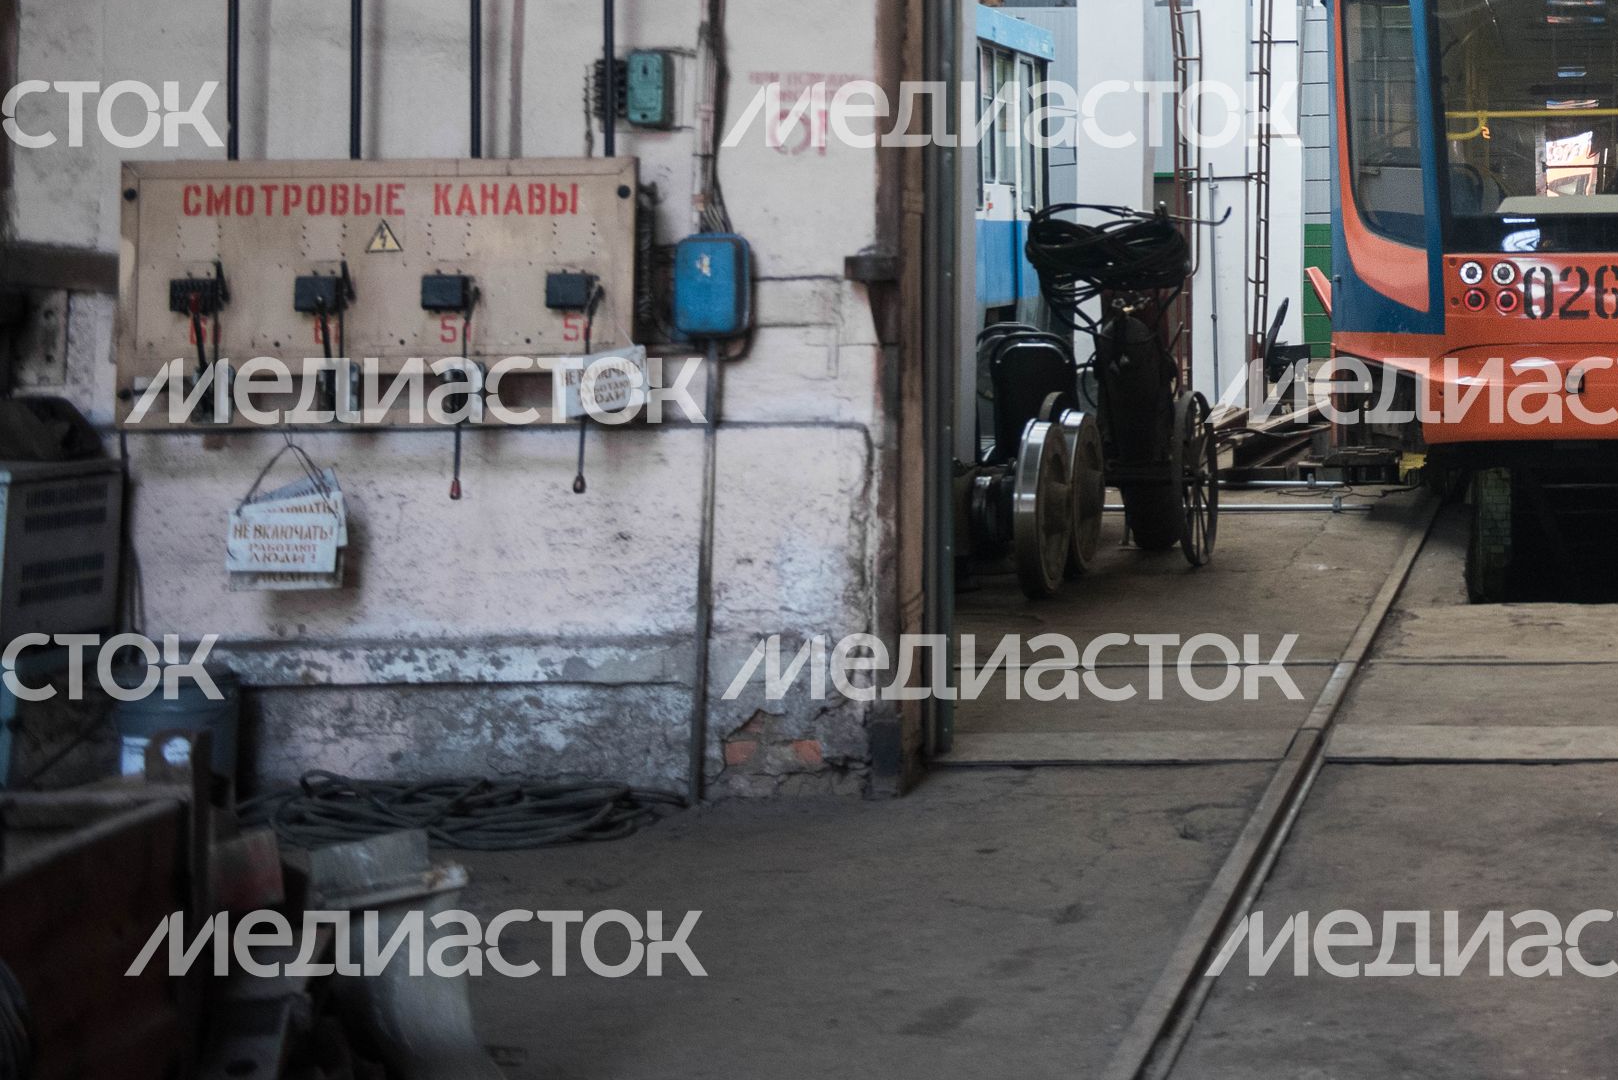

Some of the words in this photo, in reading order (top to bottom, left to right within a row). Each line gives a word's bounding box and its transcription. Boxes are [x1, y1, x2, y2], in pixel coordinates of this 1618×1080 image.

[182, 183, 405, 217] СМОТРОВЫЕ
[433, 182, 579, 216] КАНАВЫ
[233, 524, 249, 539] НЕ
[253, 525, 334, 541] ВКЛЮЧАТЬ!
[249, 543, 318, 553] РАБОТАЮТ
